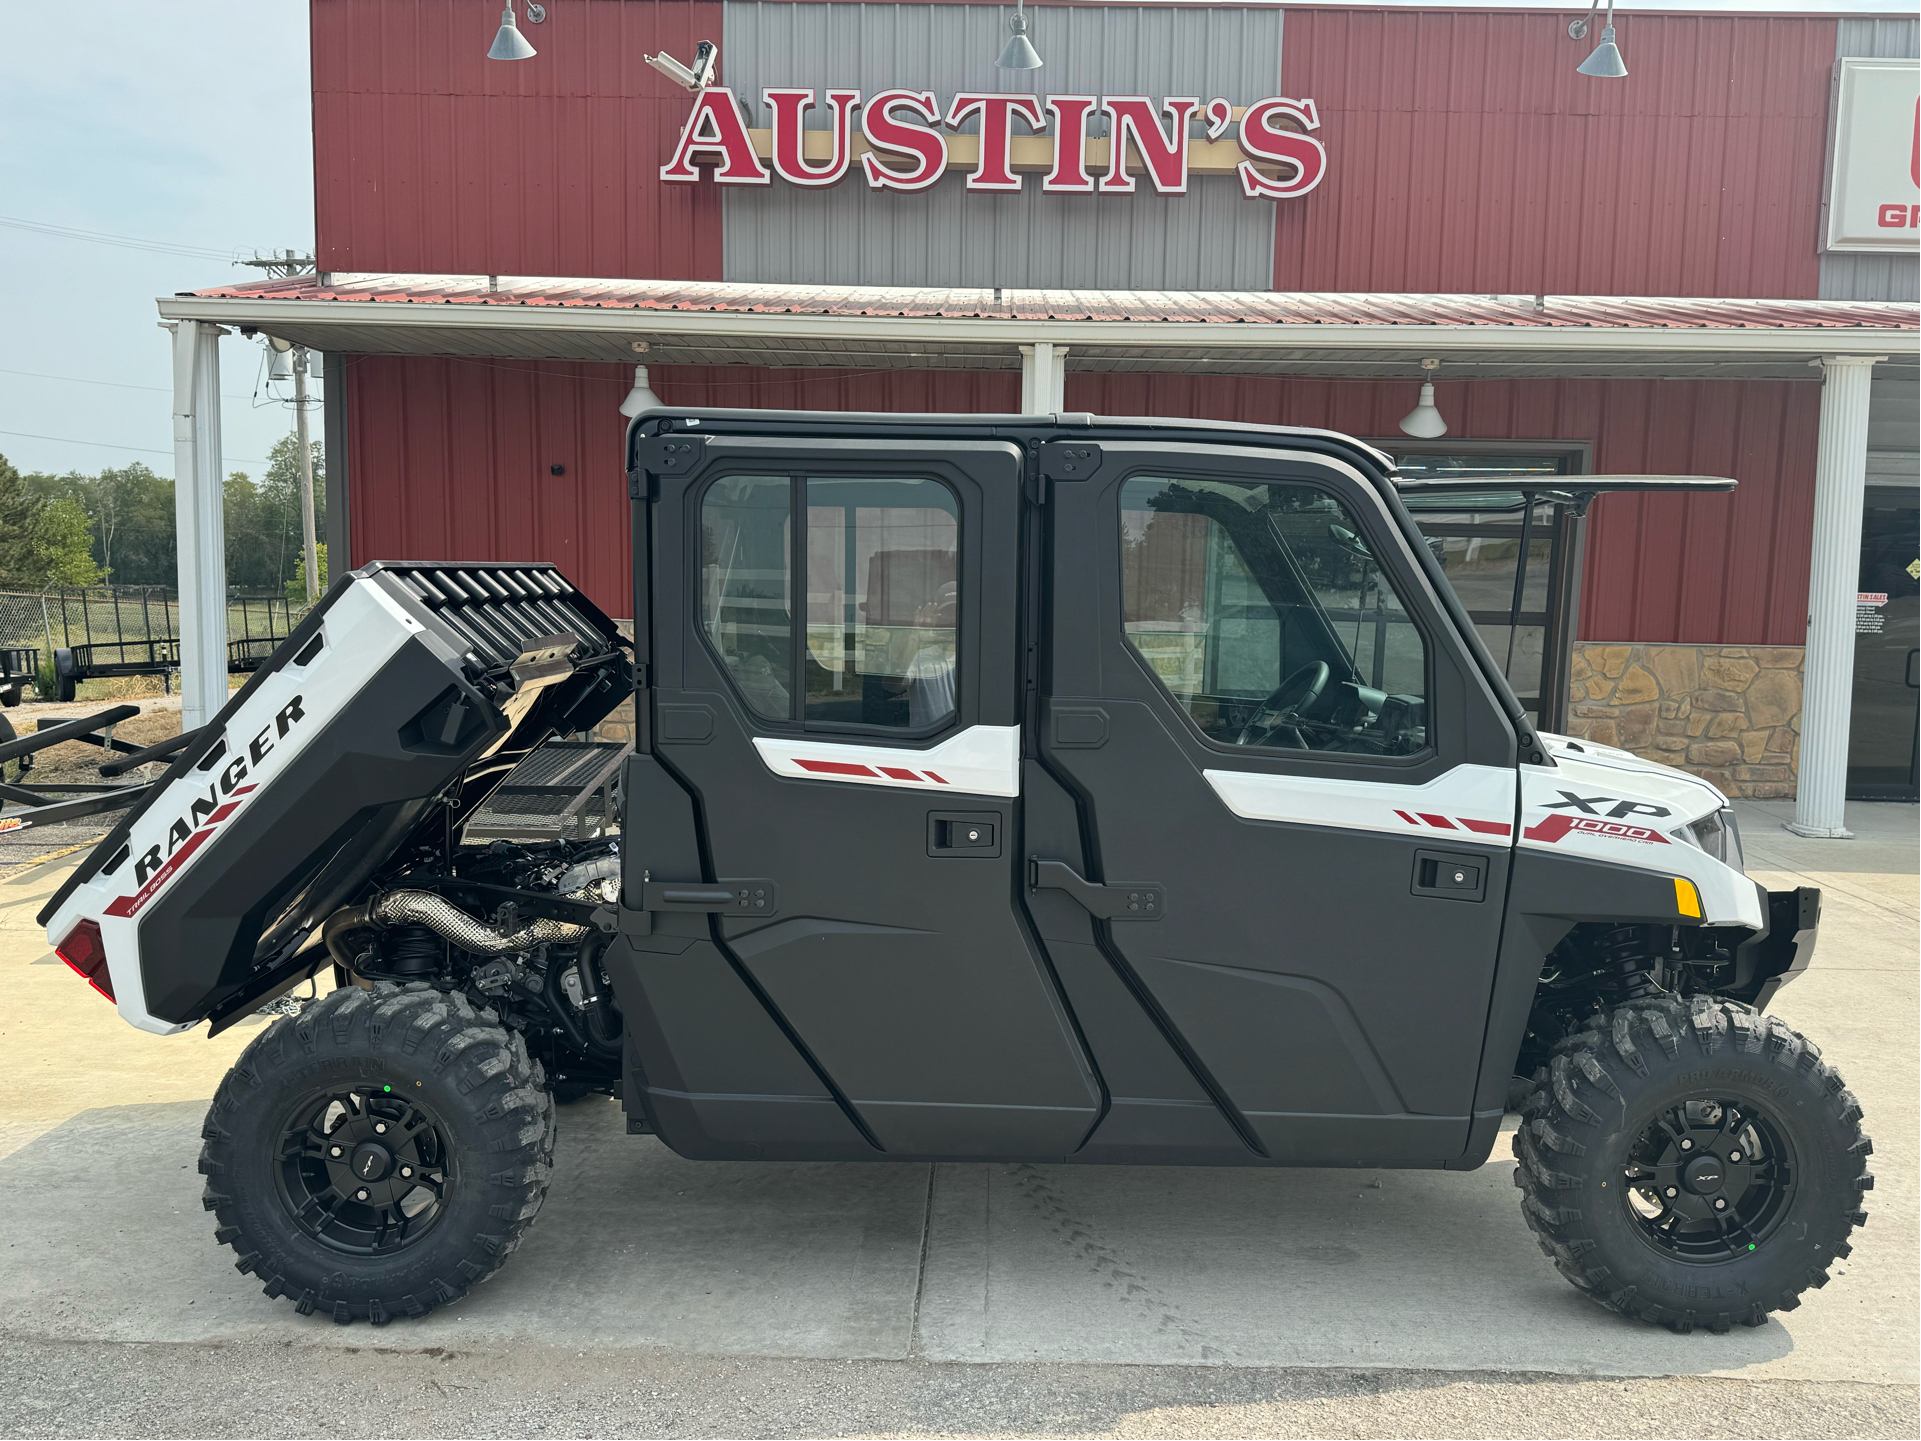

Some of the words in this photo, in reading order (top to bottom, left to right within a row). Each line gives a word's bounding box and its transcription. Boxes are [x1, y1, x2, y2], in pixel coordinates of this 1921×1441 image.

[660, 87, 1327, 198] AUSTIN'S
[134, 694, 306, 888] RANGER
[1537, 789, 1672, 819] XP
[1569, 818, 1651, 839] 1000
[1598, 833, 1637, 843] OVERHEAD
[126, 891, 151, 916] TRAIL
[150, 865, 173, 893] BOSS
[1677, 1069, 1712, 1086] PRO
[1715, 1067, 1777, 1091] ARMOR
[362, 1155, 374, 1176] XP
[1640, 1267, 1751, 1301] X-TERRAIN
